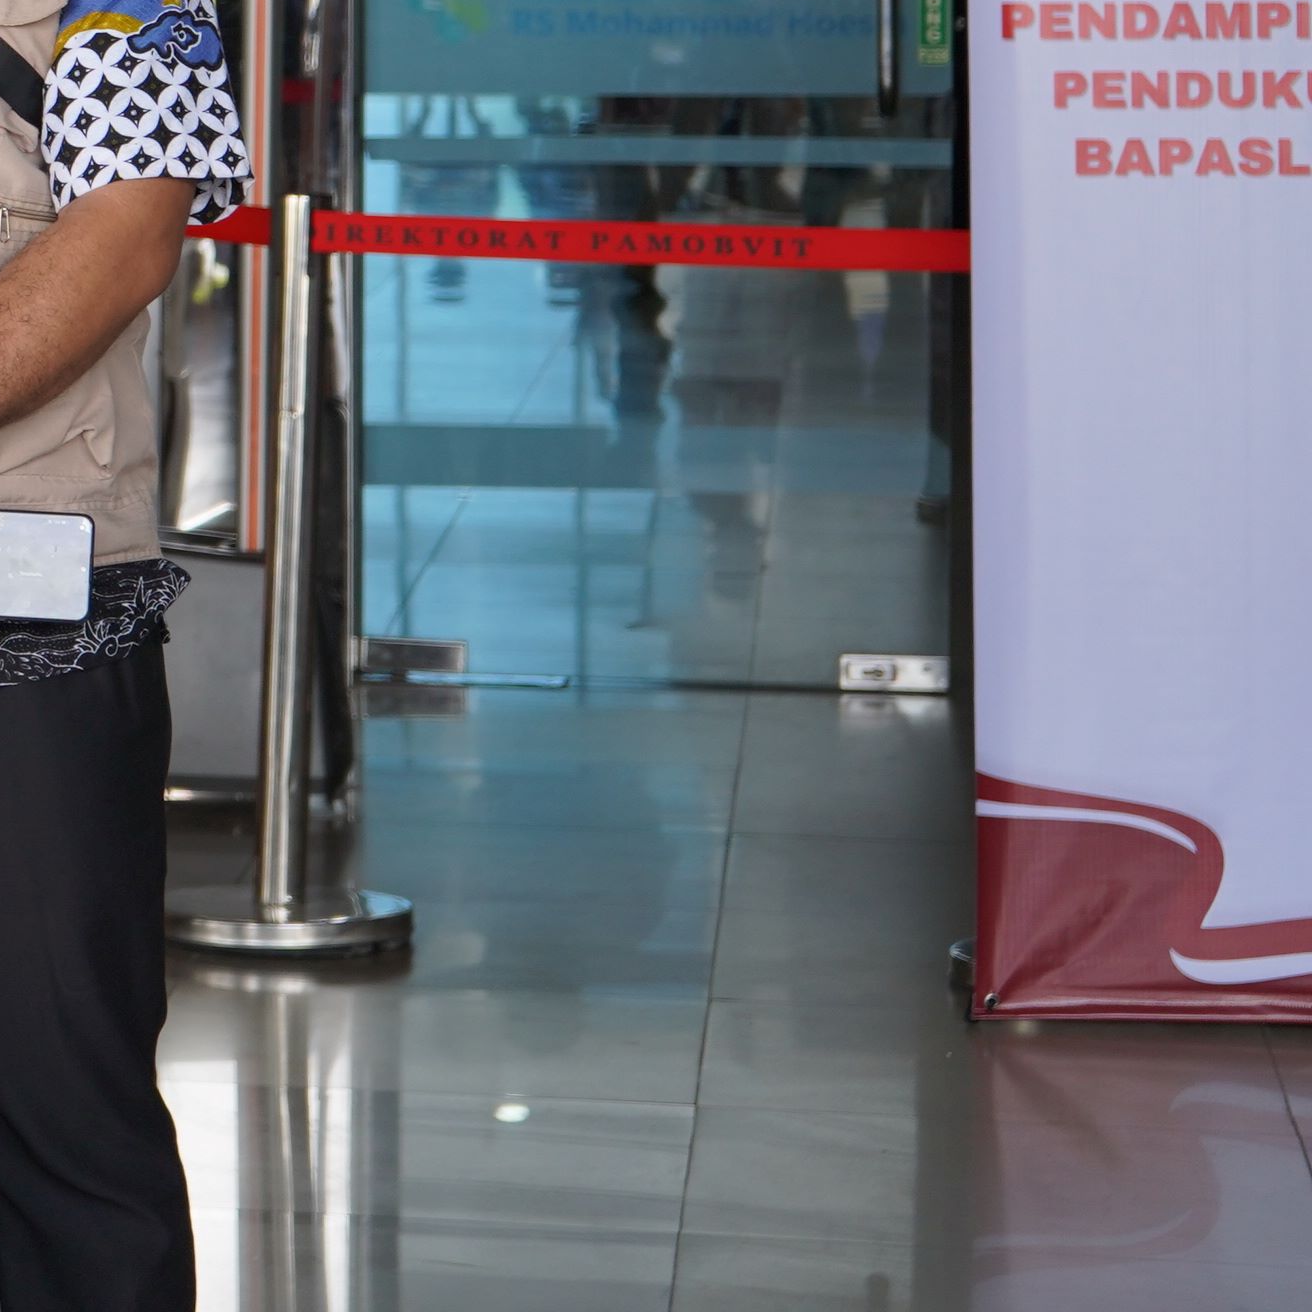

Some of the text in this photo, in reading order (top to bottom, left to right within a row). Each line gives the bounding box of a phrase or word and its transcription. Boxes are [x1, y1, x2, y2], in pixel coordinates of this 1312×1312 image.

[1053, 70, 1312, 110] PENDUK
[1075, 137, 1311, 177] BAPASL
[311, 222, 815, 259] IREKTORAT PAMOBVIT
